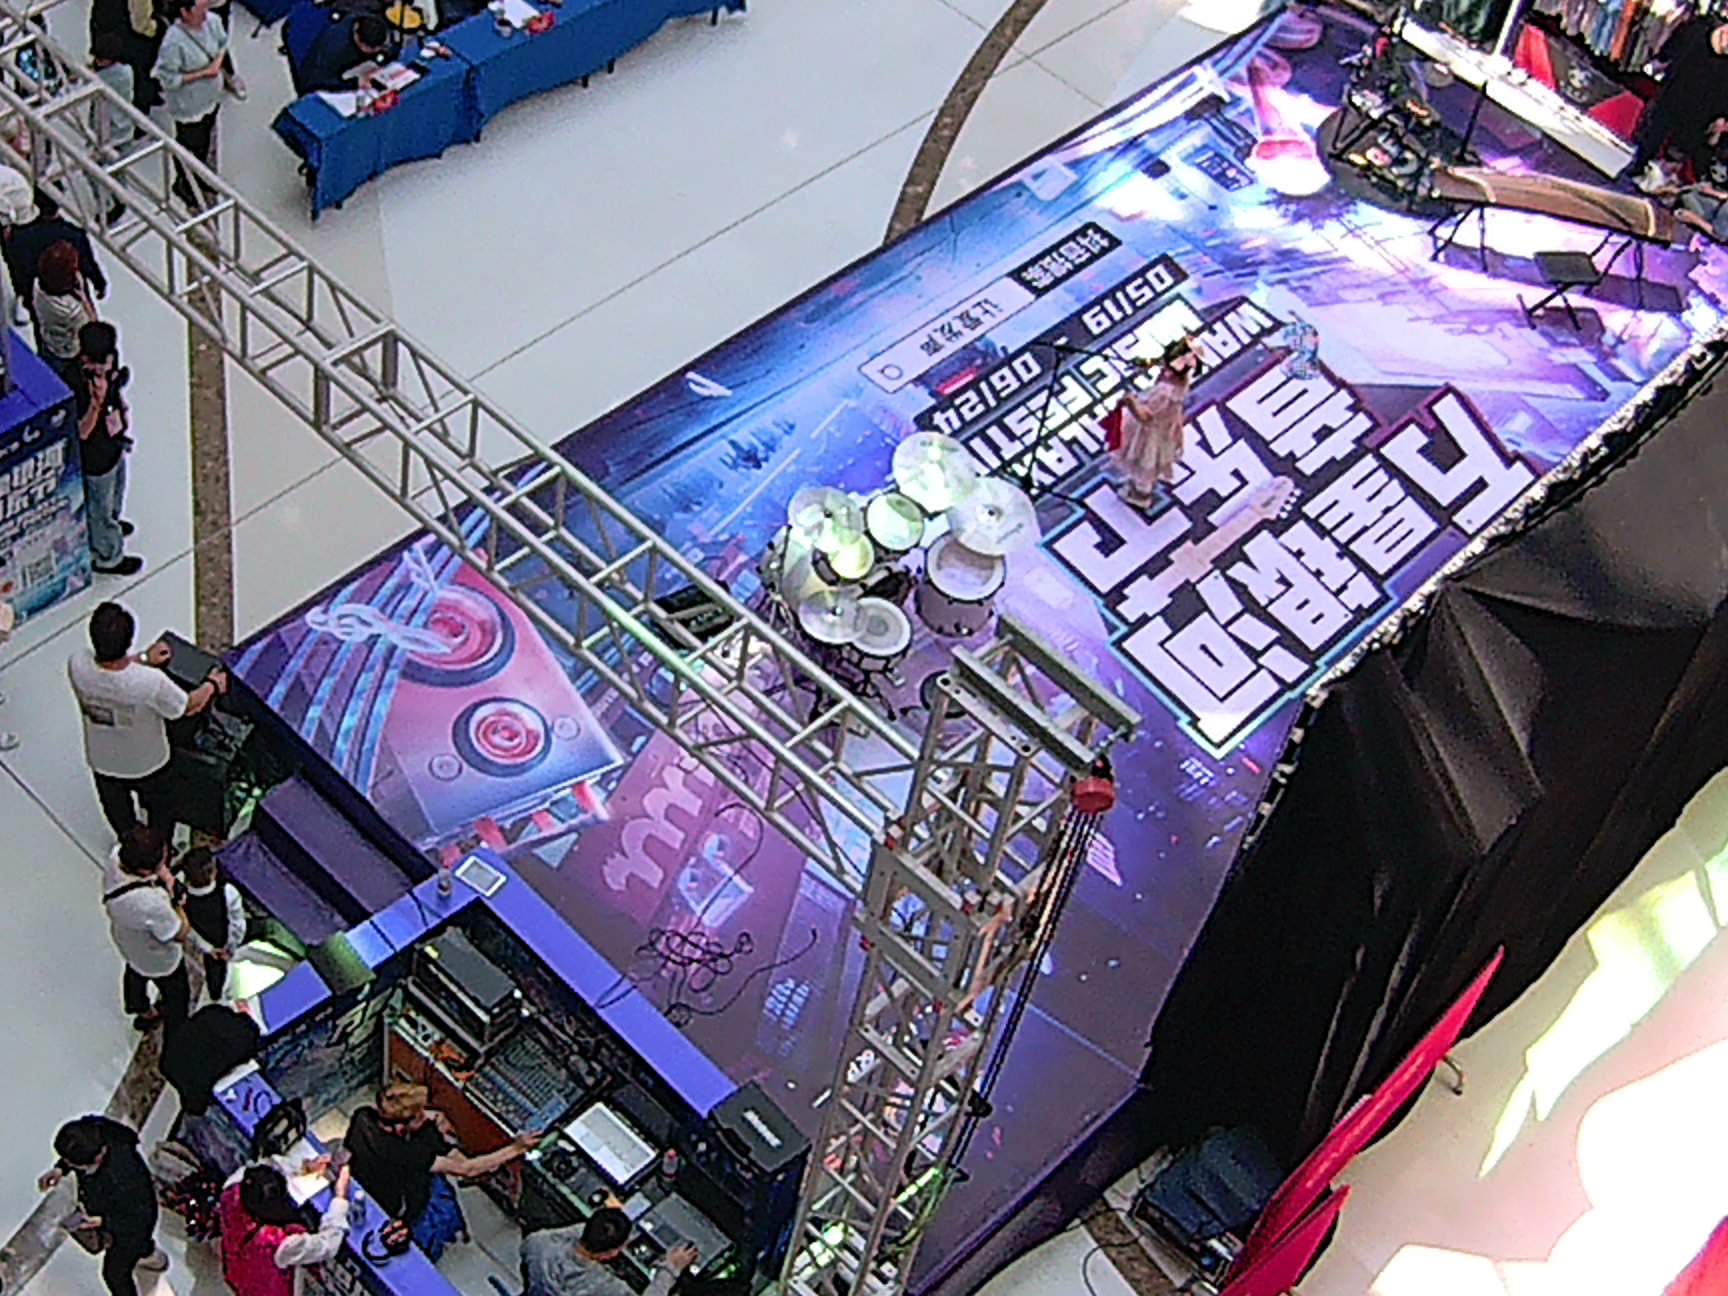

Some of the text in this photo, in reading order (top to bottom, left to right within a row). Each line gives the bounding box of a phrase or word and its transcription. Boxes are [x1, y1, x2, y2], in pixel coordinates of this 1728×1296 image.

[1081, 262, 1175, 337] 05/19
[932, 353, 1043, 435] 06/24
[1049, 365, 1374, 624] 音乐节
[1120, 391, 1540, 747] 万星银河
